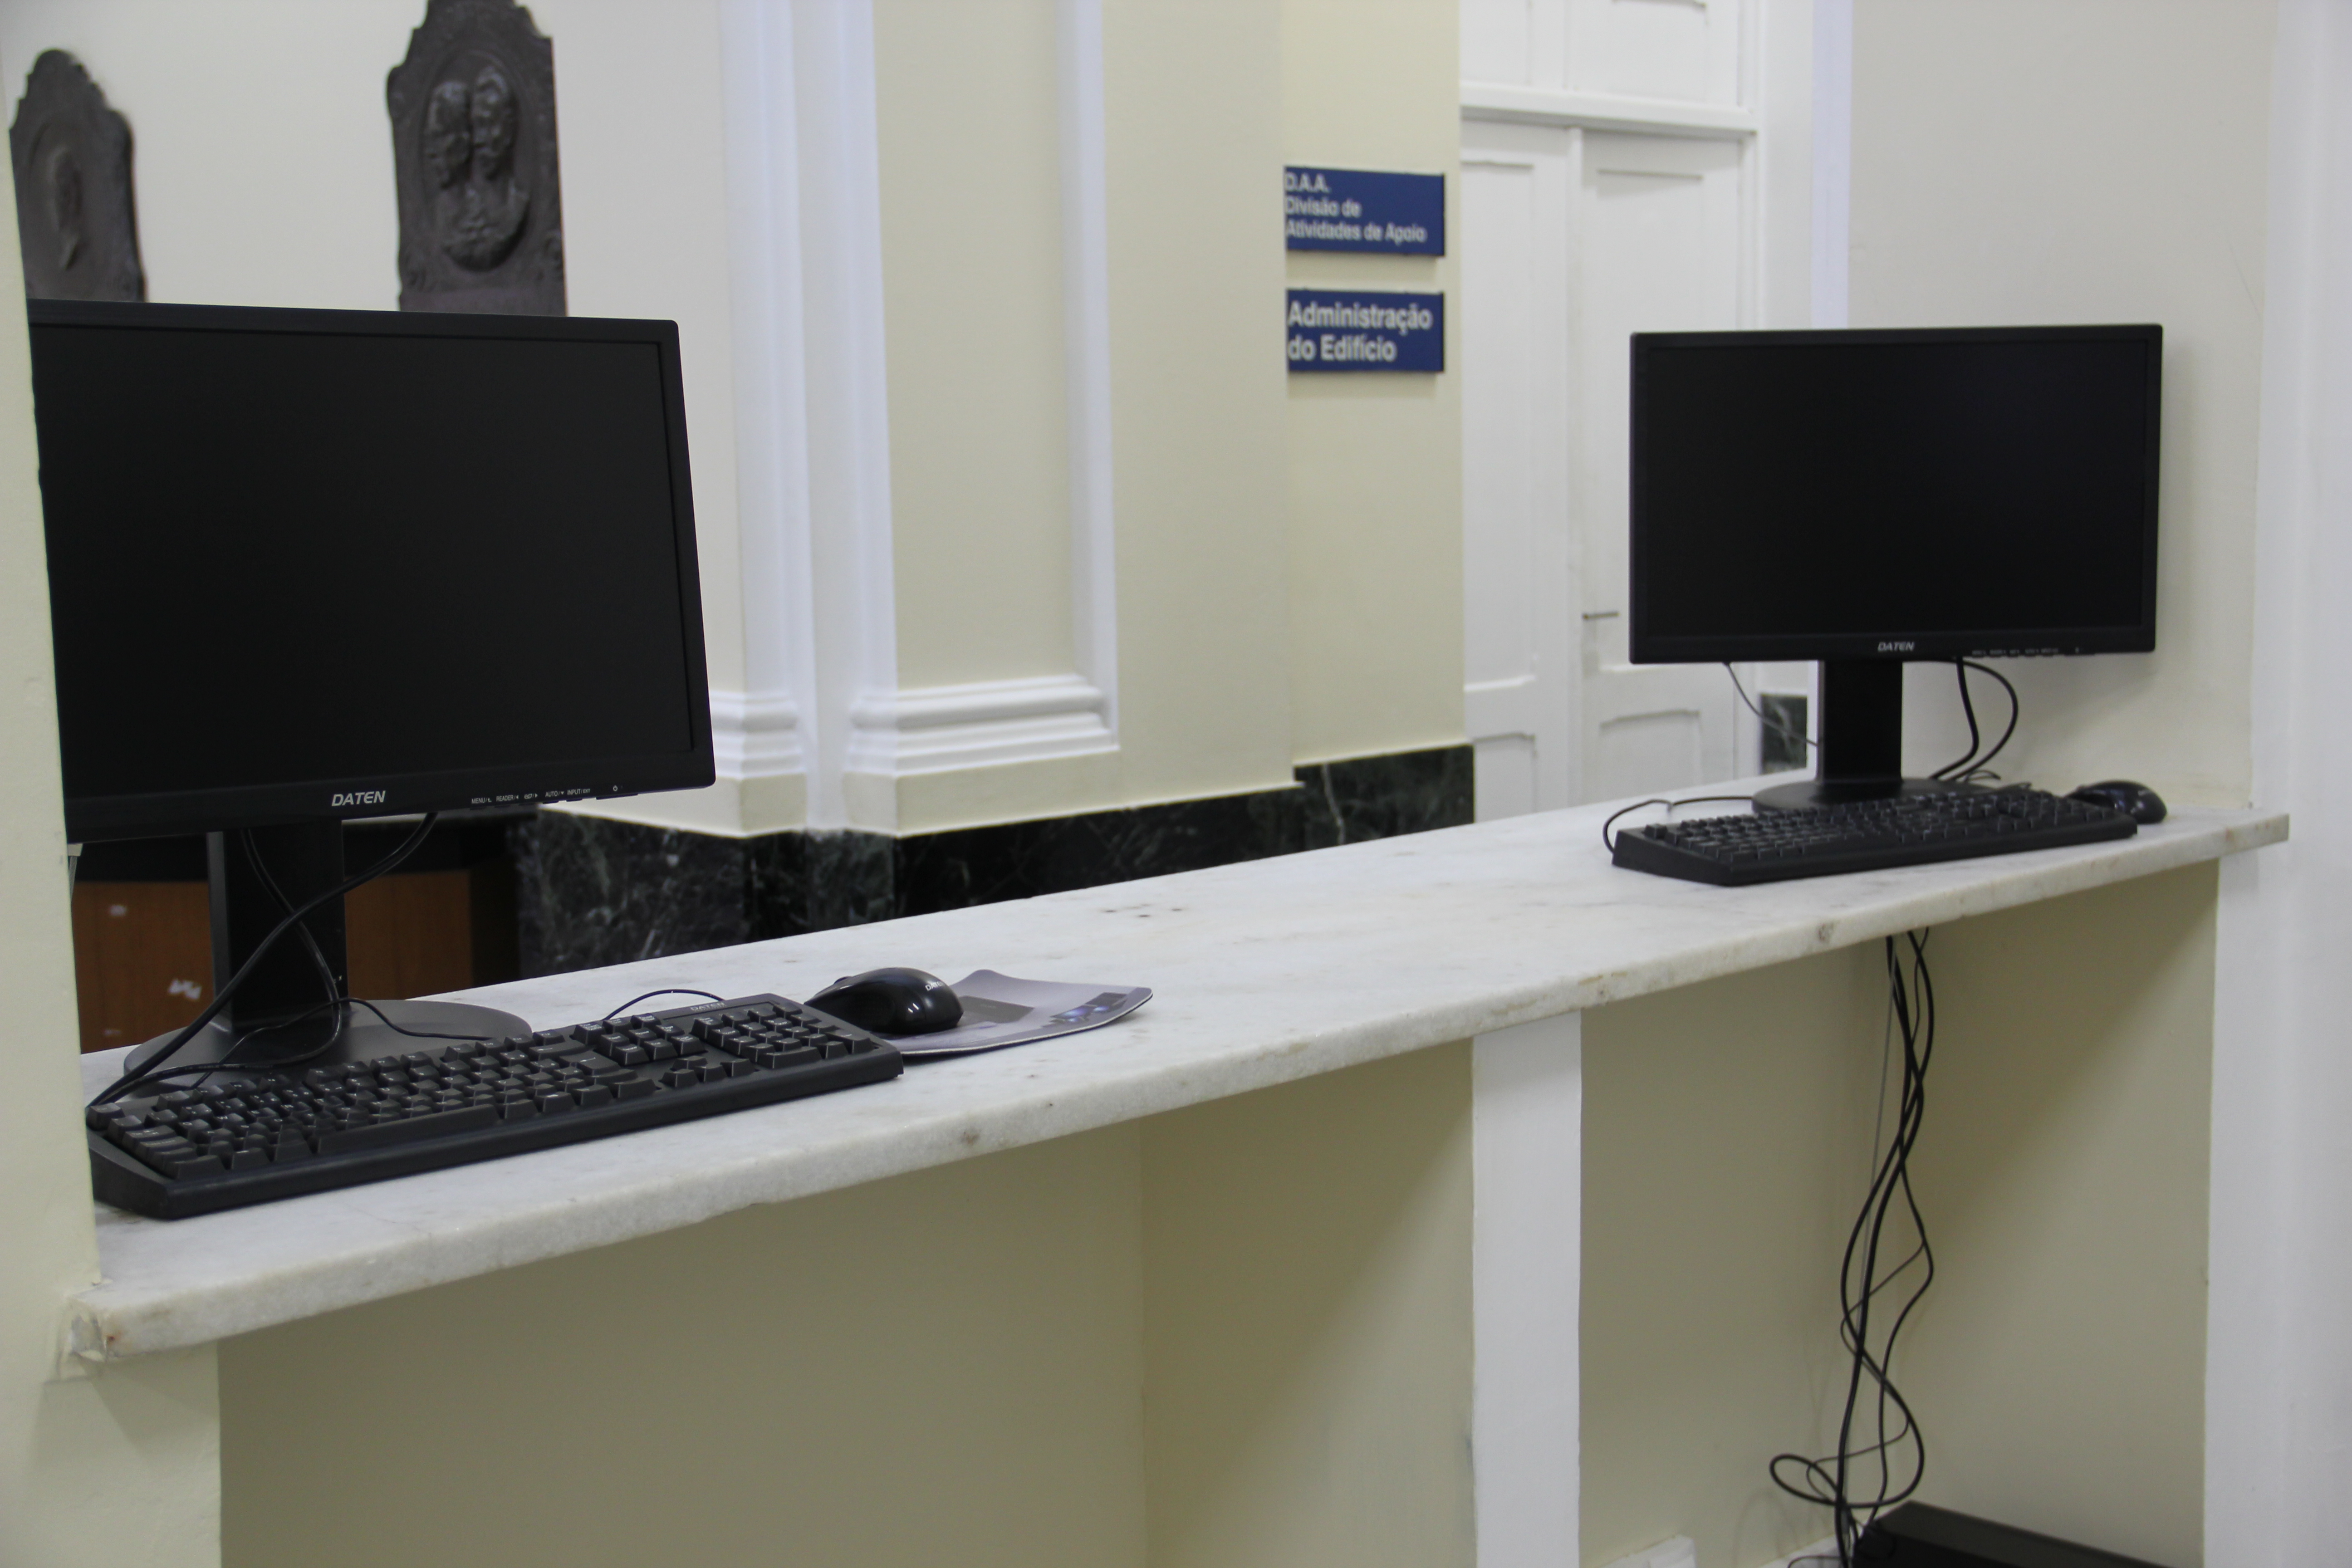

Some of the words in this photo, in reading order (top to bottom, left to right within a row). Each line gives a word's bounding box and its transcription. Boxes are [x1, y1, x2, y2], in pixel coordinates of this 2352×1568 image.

[1285, 172, 1331, 192] D.A.A.
[1286, 196, 1340, 216] Divisão
[1341, 199, 1361, 217] de
[1287, 219, 1361, 240] Atividades
[1364, 222, 1383, 240] de
[1385, 223, 1427, 245] Apoio
[1288, 301, 1433, 335] Administração
[1288, 335, 1315, 360] do
[1321, 334, 1397, 361] Edifício
[331, 790, 386, 806] DATEN
